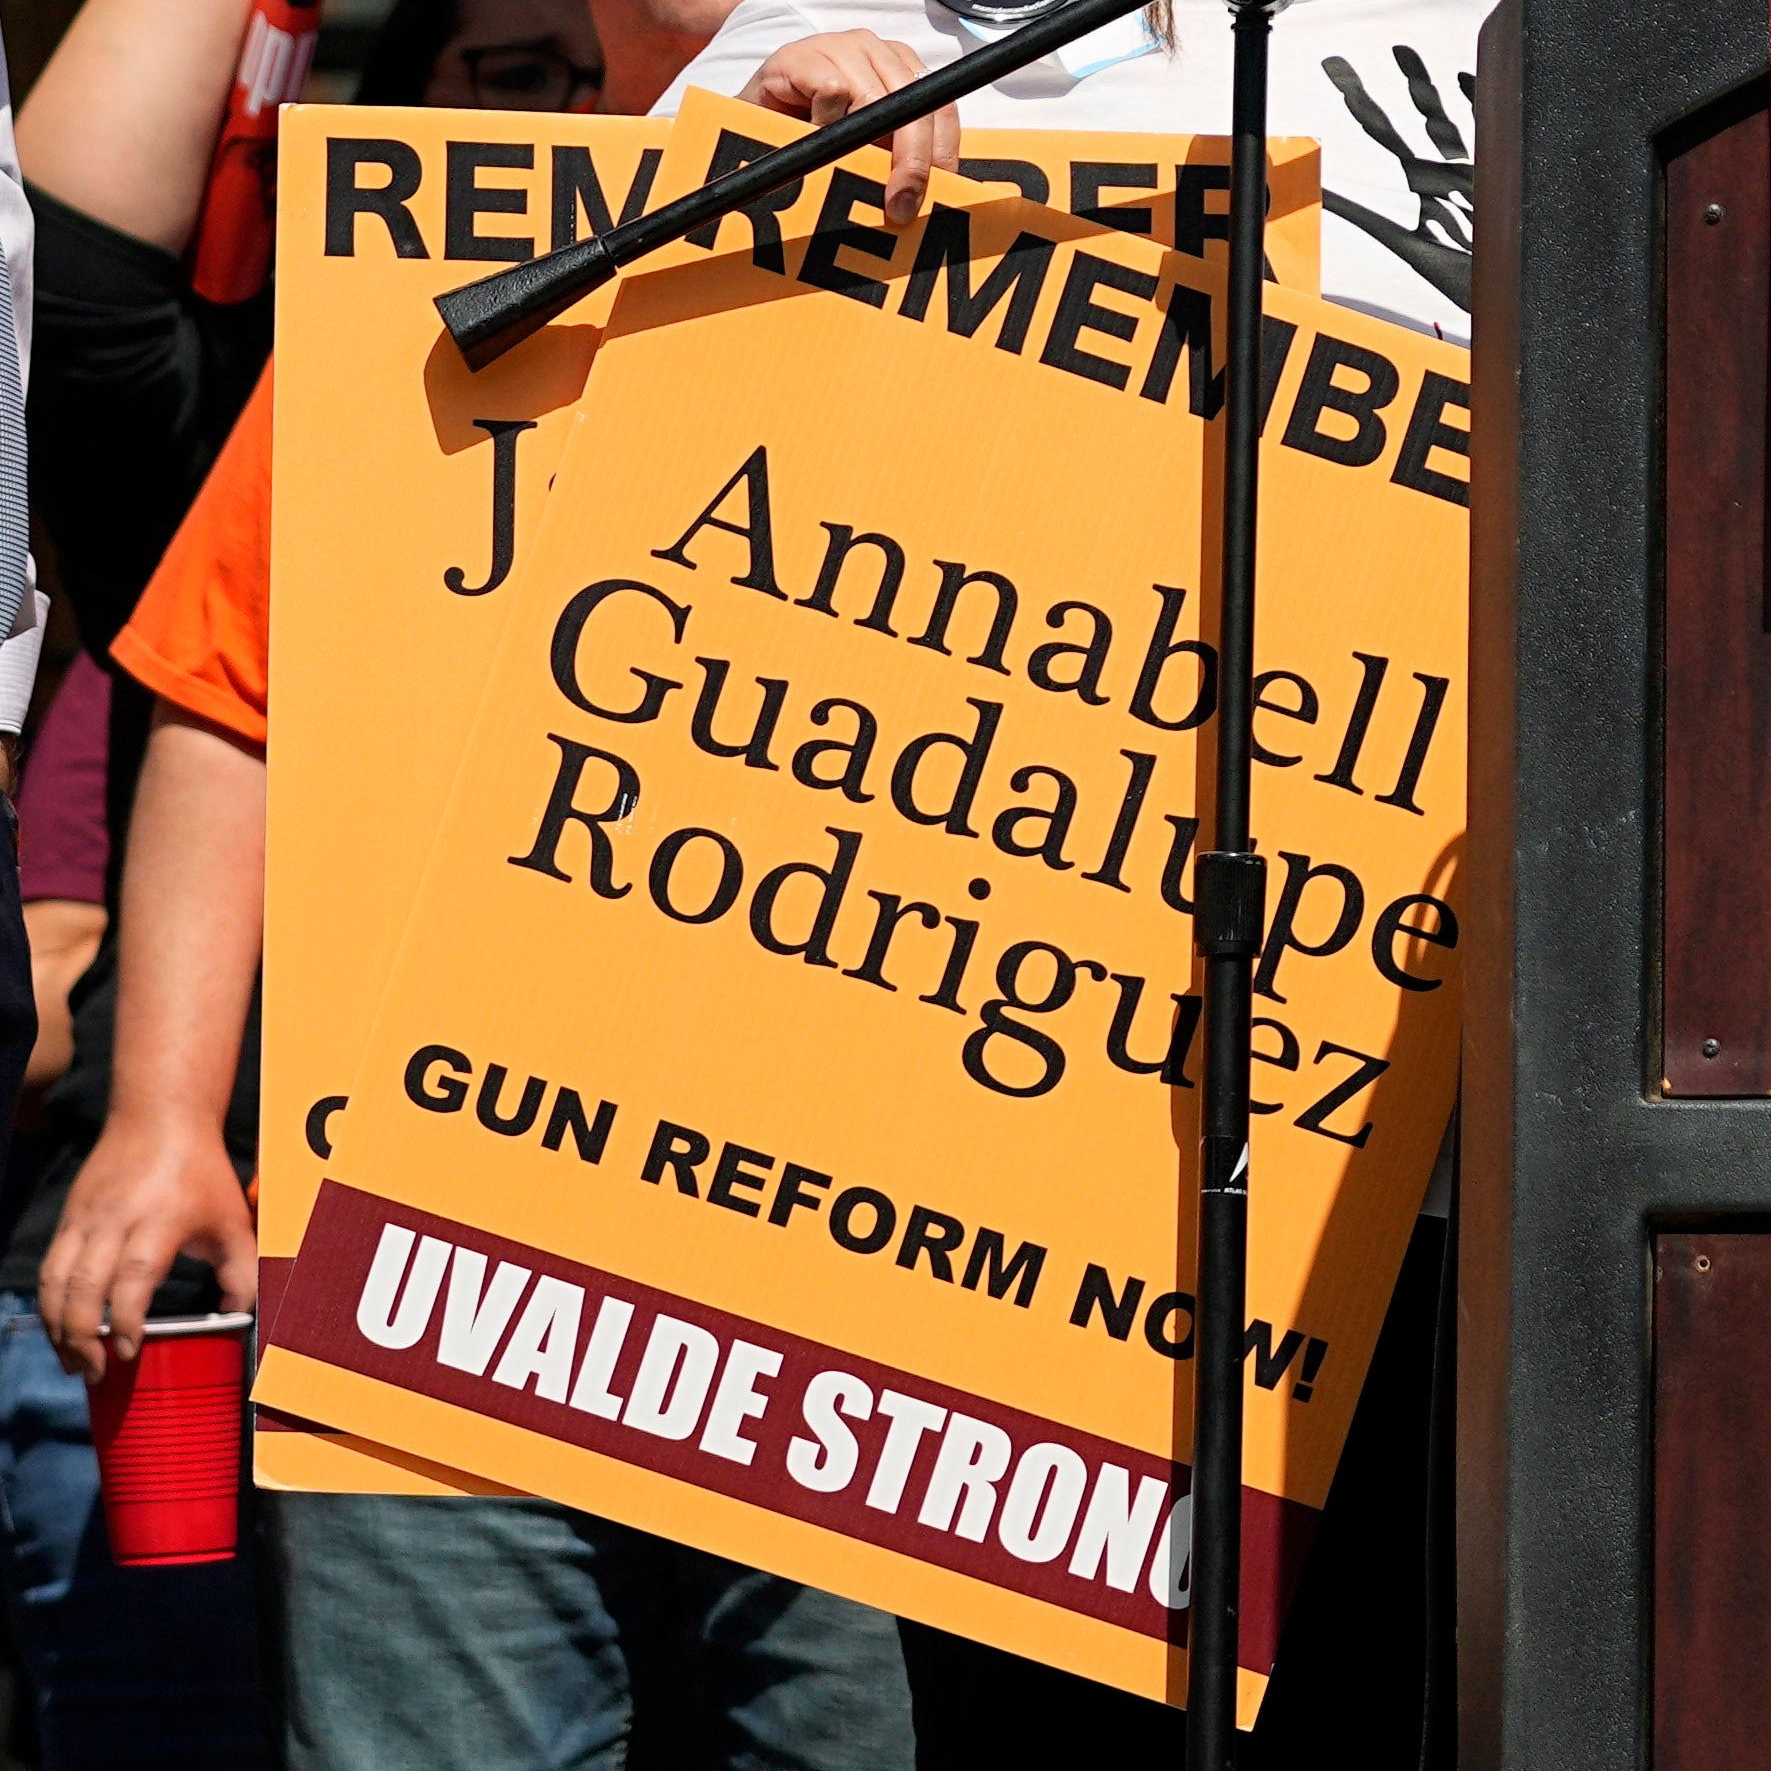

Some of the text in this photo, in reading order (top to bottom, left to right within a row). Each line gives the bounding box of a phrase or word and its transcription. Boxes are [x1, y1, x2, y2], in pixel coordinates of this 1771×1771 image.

[650, 444, 1449, 818] Annabell
[401, 1044, 619, 1166] GUN
[640, 1120, 1045, 1312] REFORM
[355, 1223, 785, 1466] UVALDE
